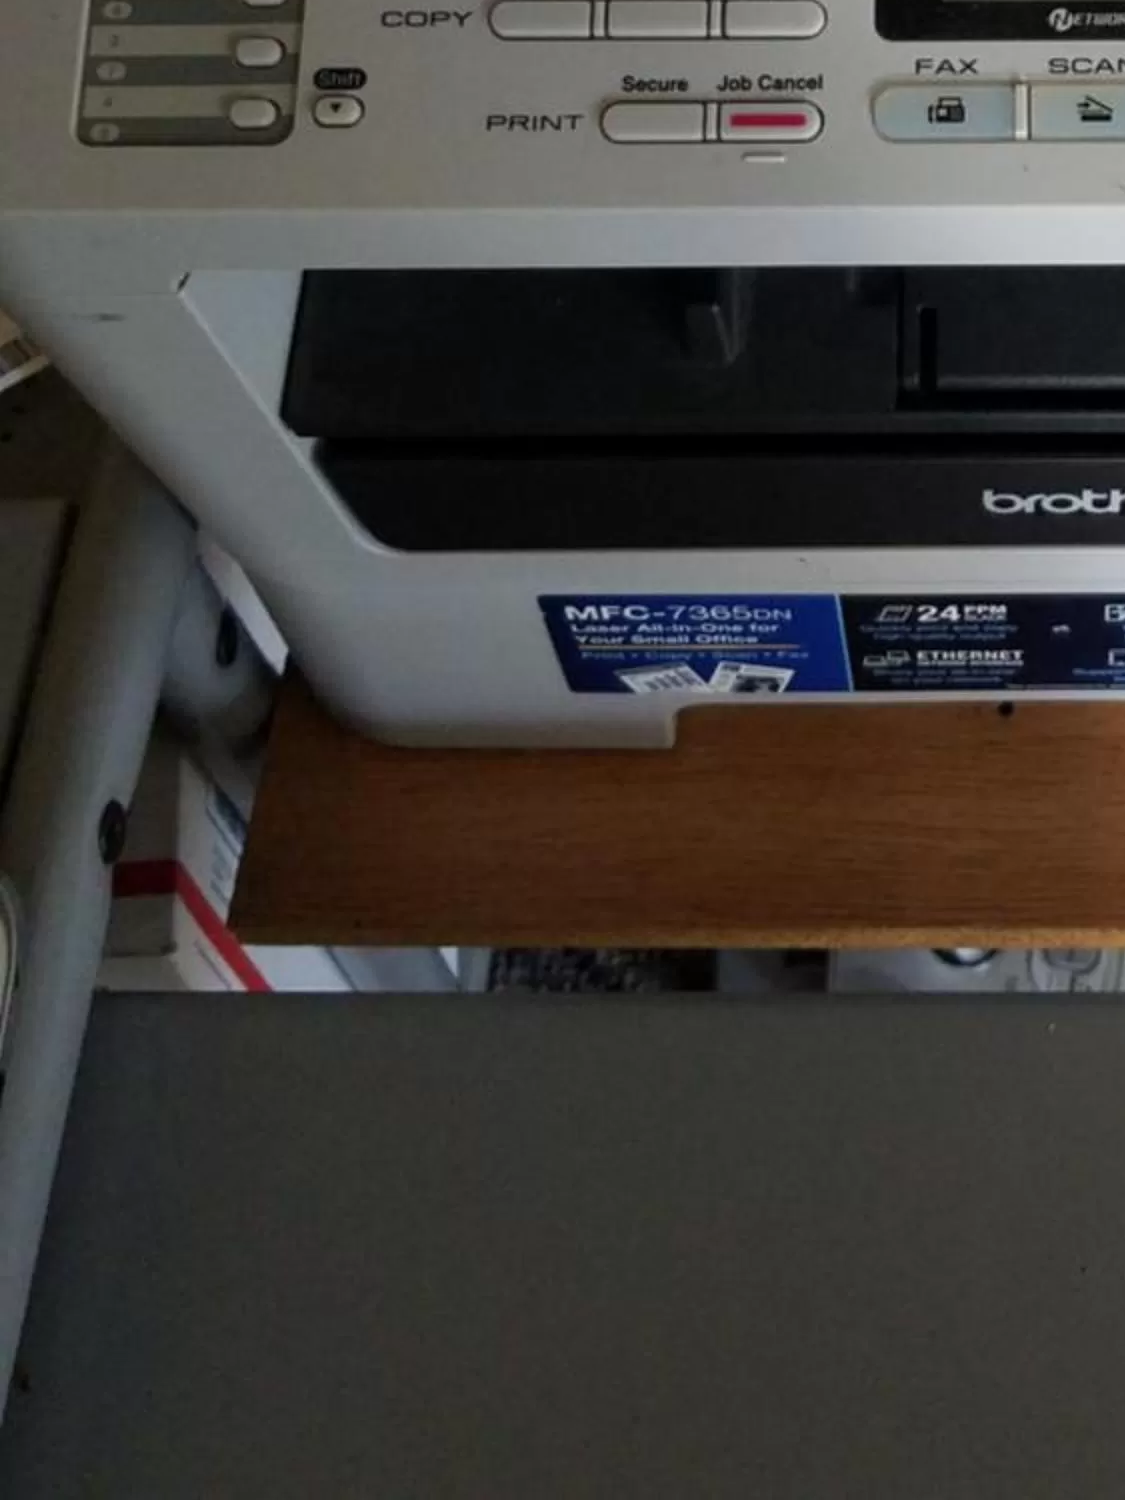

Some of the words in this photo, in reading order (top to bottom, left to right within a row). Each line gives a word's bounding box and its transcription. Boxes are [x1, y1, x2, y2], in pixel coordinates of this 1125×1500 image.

[381, 11, 473, 28] COPY
[915, 58, 980, 75] FAX
[622, 76, 689, 93] Secure
[717, 75, 752, 92] Job
[757, 75, 824, 92] Cancel
[486, 115, 585, 132] PRINT
[563, 605, 792, 621] MFC-7365DN
[917, 604, 961, 622] 24
[570, 624, 629, 633] Laser
[750, 623, 779, 632] for
[575, 635, 627, 644] Your
[630, 635, 690, 644] Small
[695, 634, 759, 644] Office
[916, 650, 1024, 661] ETHERNET
